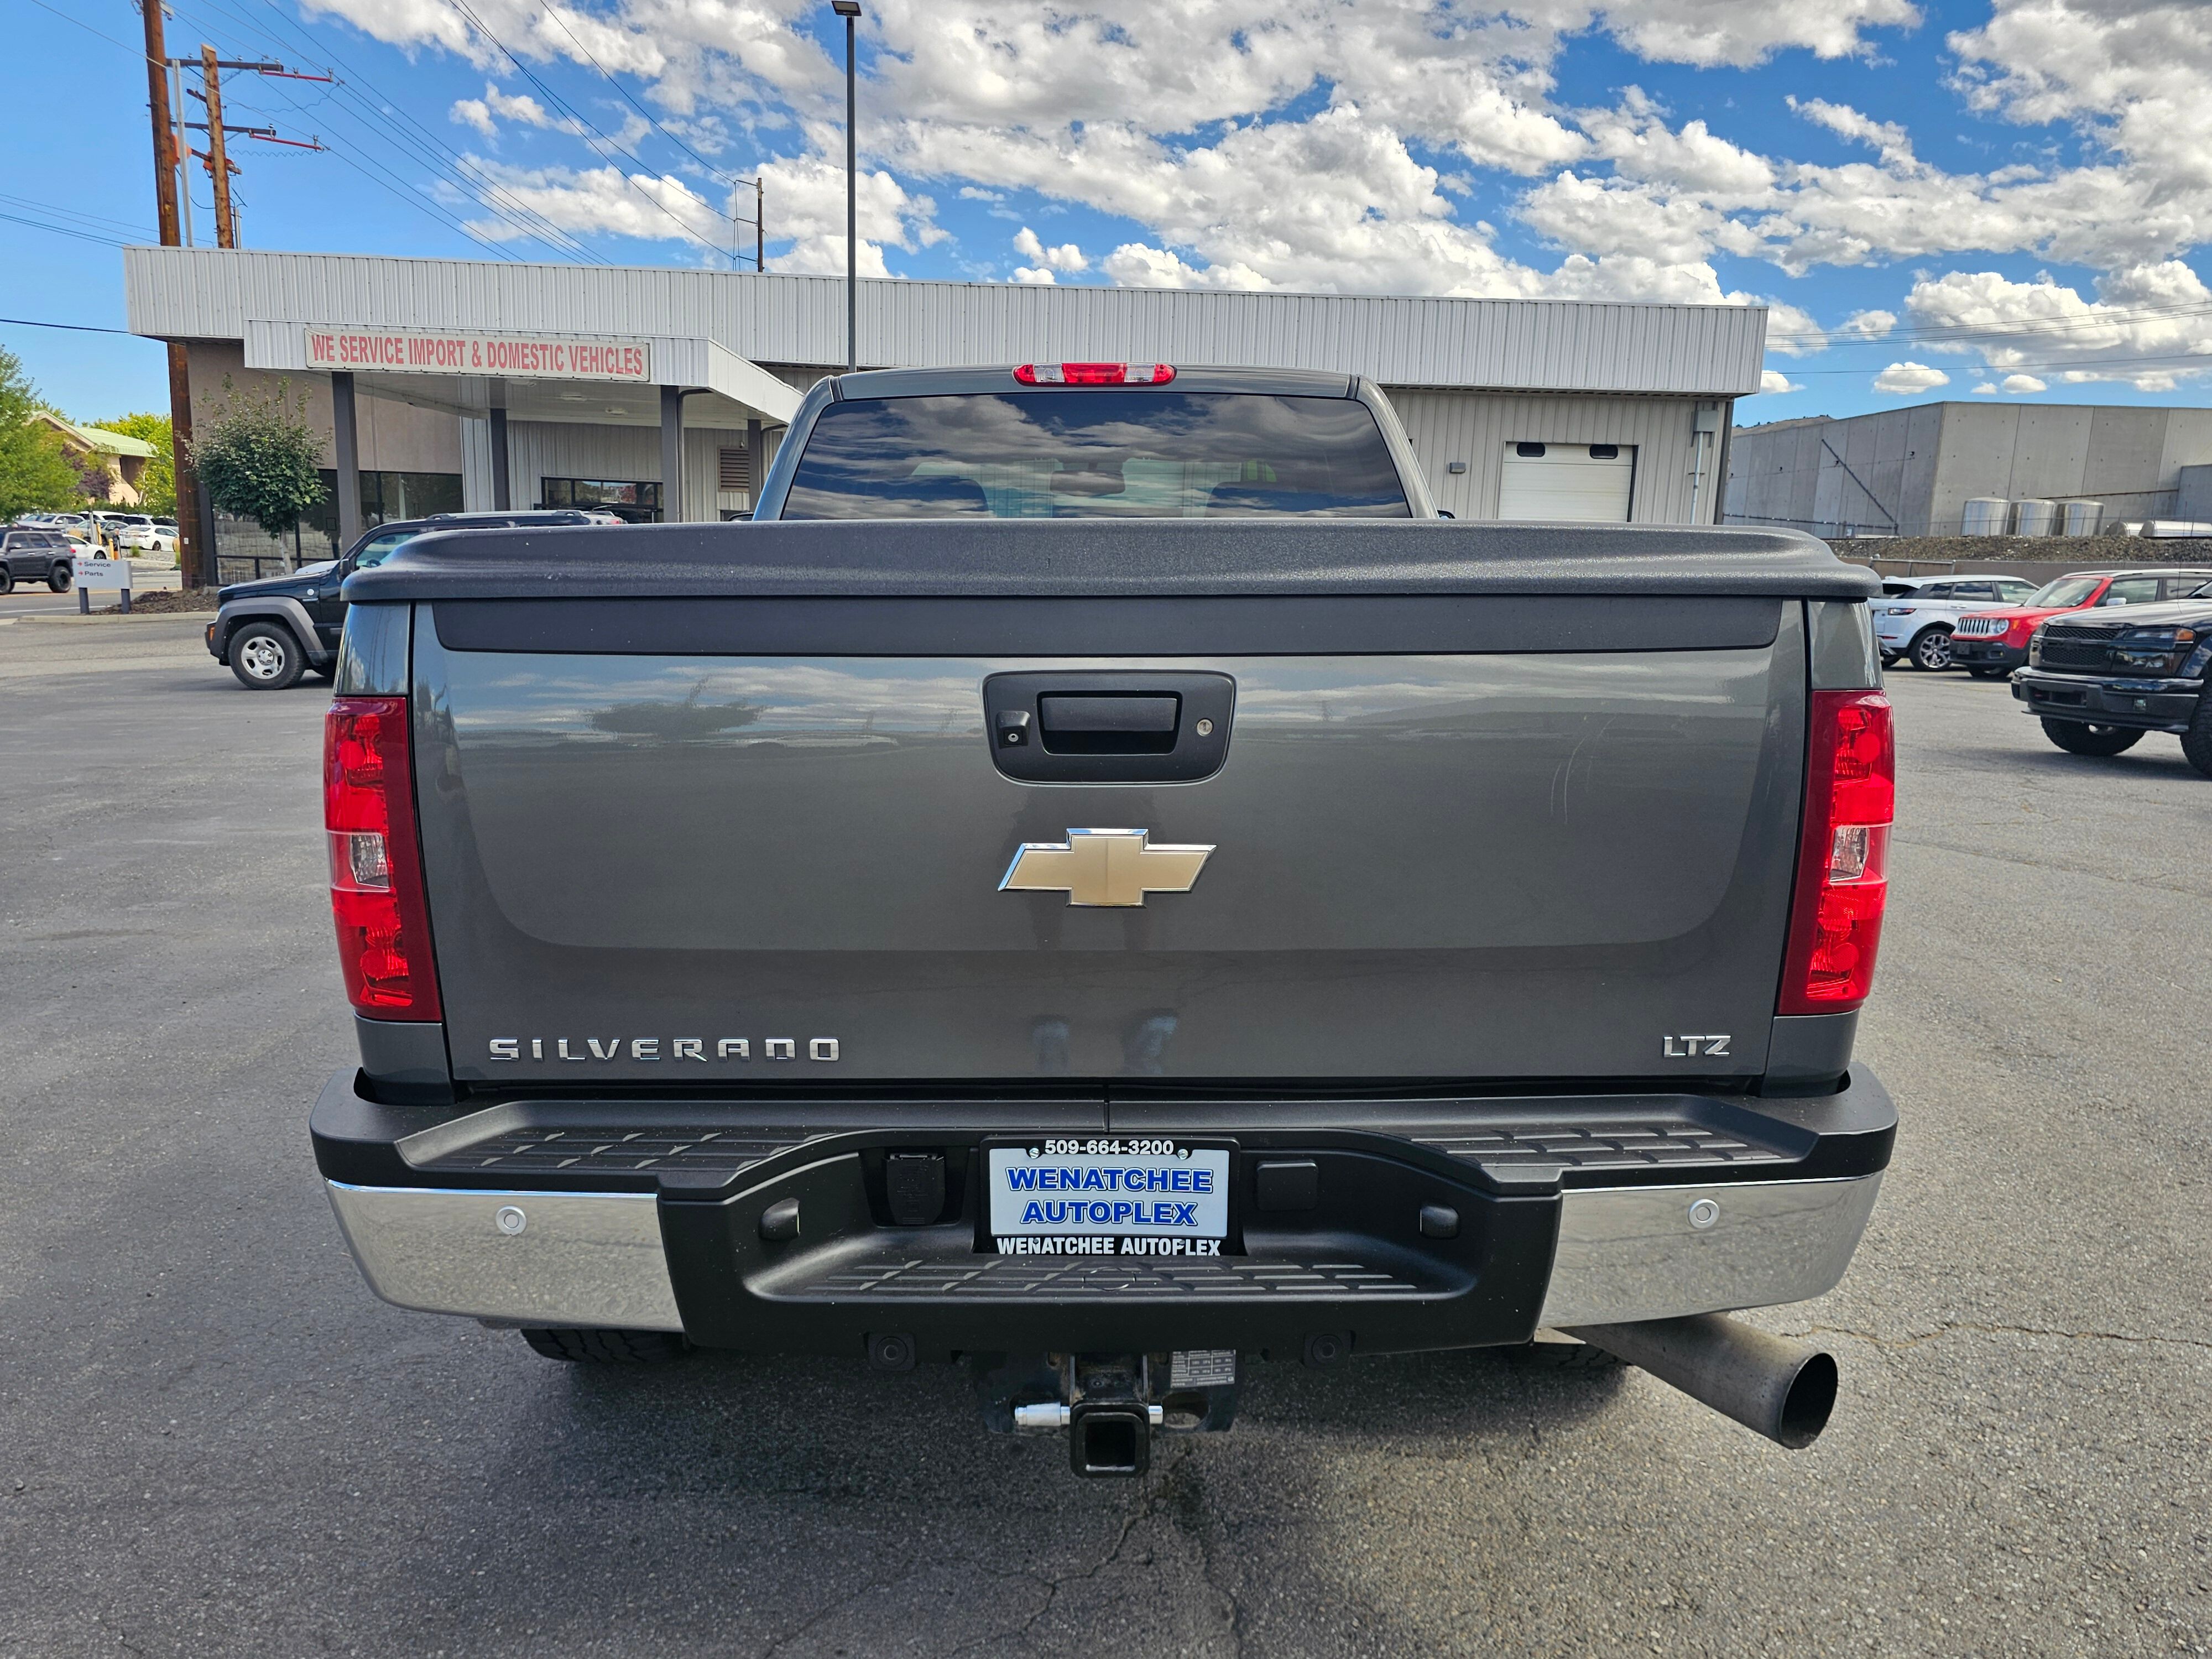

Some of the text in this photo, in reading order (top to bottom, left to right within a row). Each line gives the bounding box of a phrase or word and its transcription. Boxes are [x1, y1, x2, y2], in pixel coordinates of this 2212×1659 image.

[311, 335, 643, 375] WE SERVICE IMPORT & DOMESTIC VEHICLES
[489, 1038, 840, 1062] SILVERADO
[1663, 1035, 1731, 1057] LTZ
[1045, 1139, 1174, 1155] 509-664-3200
[1005, 1167, 1213, 1194] WENATCHEE
[1020, 1199, 1198, 1226] AUTOPLEX
[997, 1237, 1221, 1256] WENATCHEE AUTOPLEX
